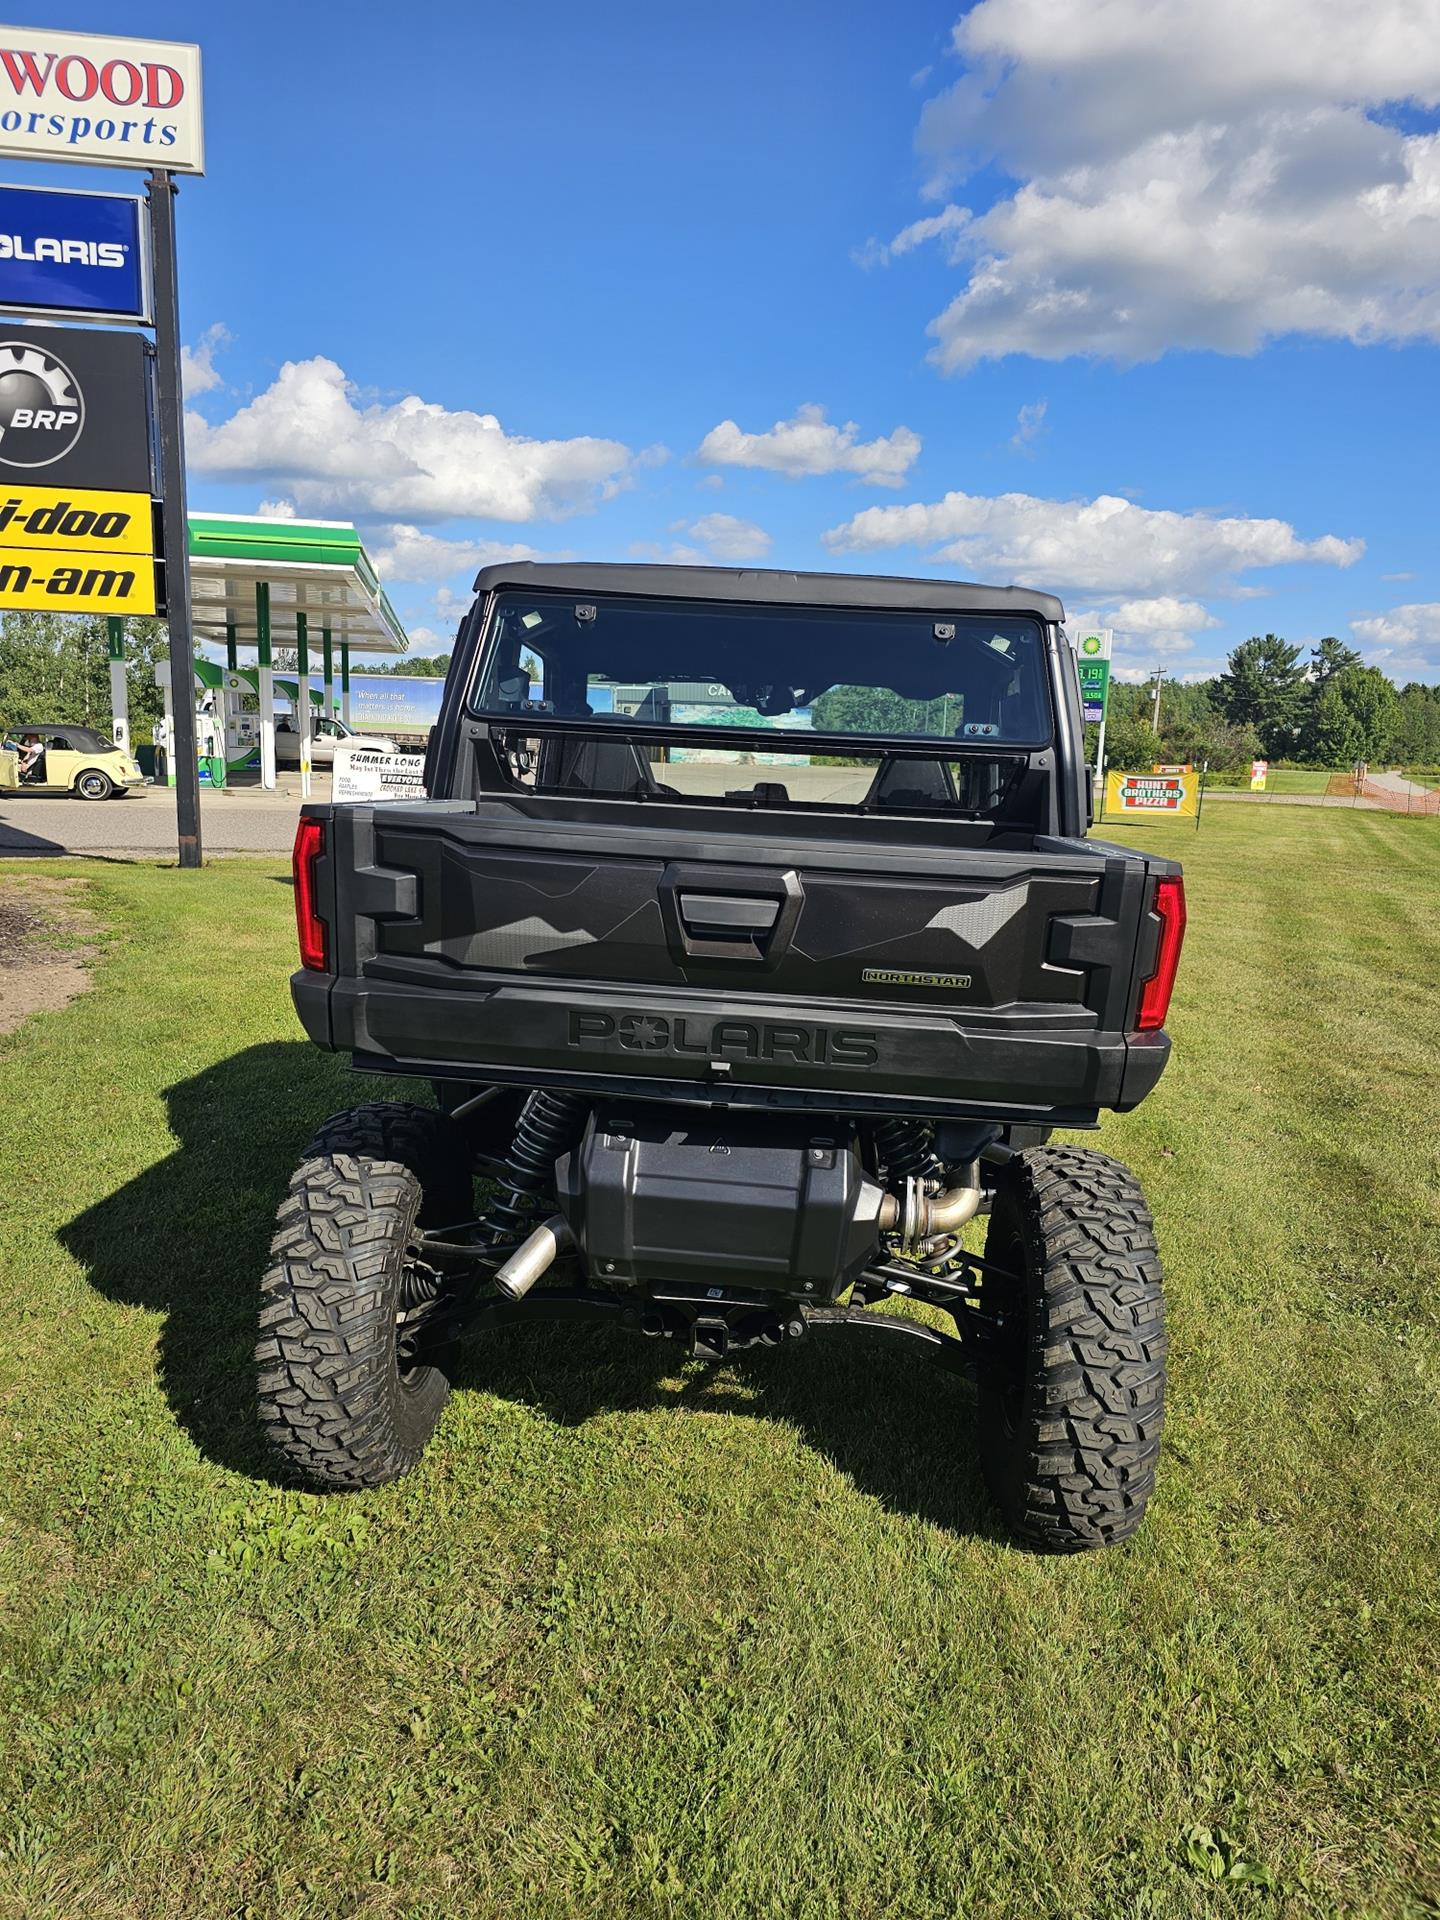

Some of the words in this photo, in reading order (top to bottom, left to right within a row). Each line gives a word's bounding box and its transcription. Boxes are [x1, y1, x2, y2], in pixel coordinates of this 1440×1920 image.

[0, 48, 185, 109] WOOD
[1, 110, 178, 146] orsports
[10, 408, 79, 431] BRP
[0, 564, 136, 598] n-am
[358, 690, 378, 700] When
[379, 692, 389, 700] all
[390, 692, 405, 701] that
[350, 754, 391, 765] SUMMER
[394, 758, 421, 767] LONG
[350, 764, 362, 772] May
[1136, 780, 1168, 789] HUNT
[1124, 788, 1180, 798] BROTHERS
[1135, 797, 1168, 806] PIZZA
[866, 971, 968, 986] NORTHSTAR
[568, 1010, 878, 1067] POLARIS
